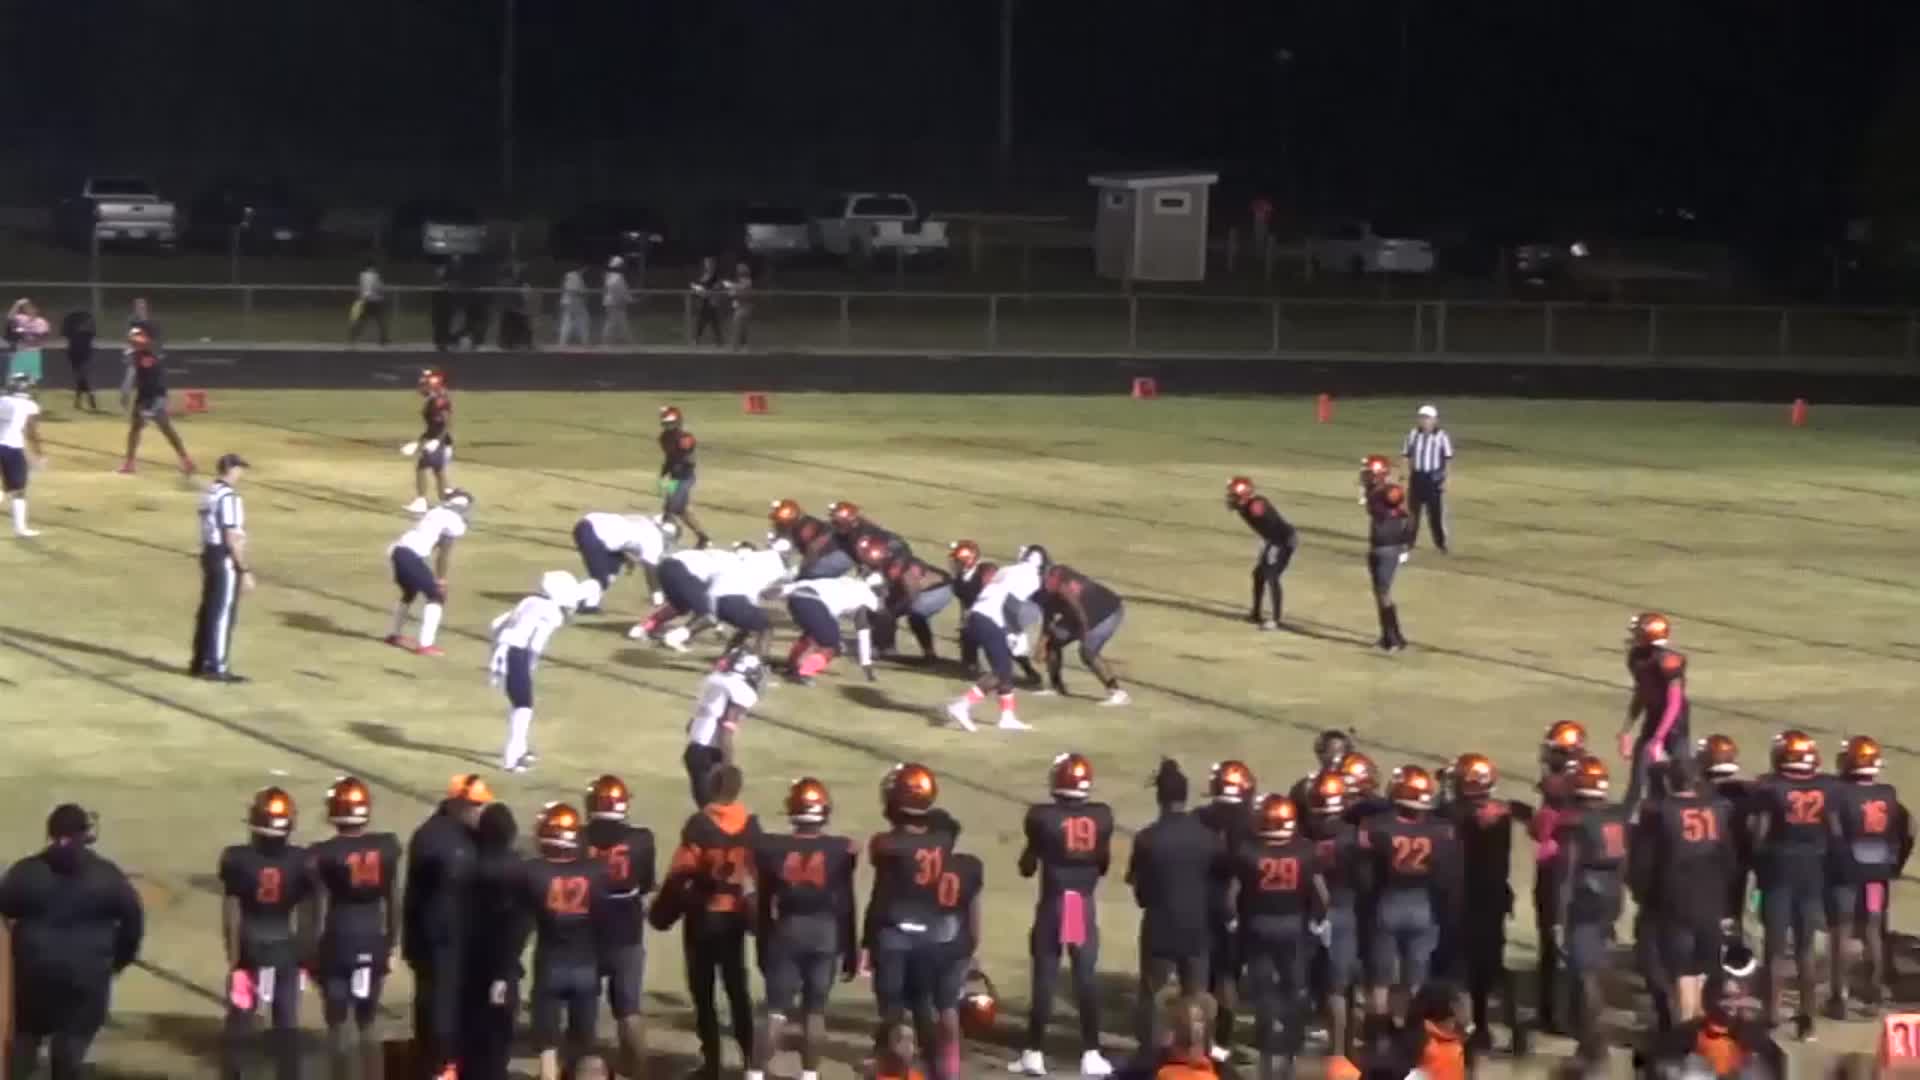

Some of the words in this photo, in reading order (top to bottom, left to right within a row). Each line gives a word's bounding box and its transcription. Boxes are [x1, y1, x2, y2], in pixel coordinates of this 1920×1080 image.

[1785, 789, 1825, 824] 32
[1061, 816, 1097, 851] 19
[1681, 807, 1719, 842] 51
[1392, 835, 1434, 873] 22
[546, 876, 591, 914] 42
